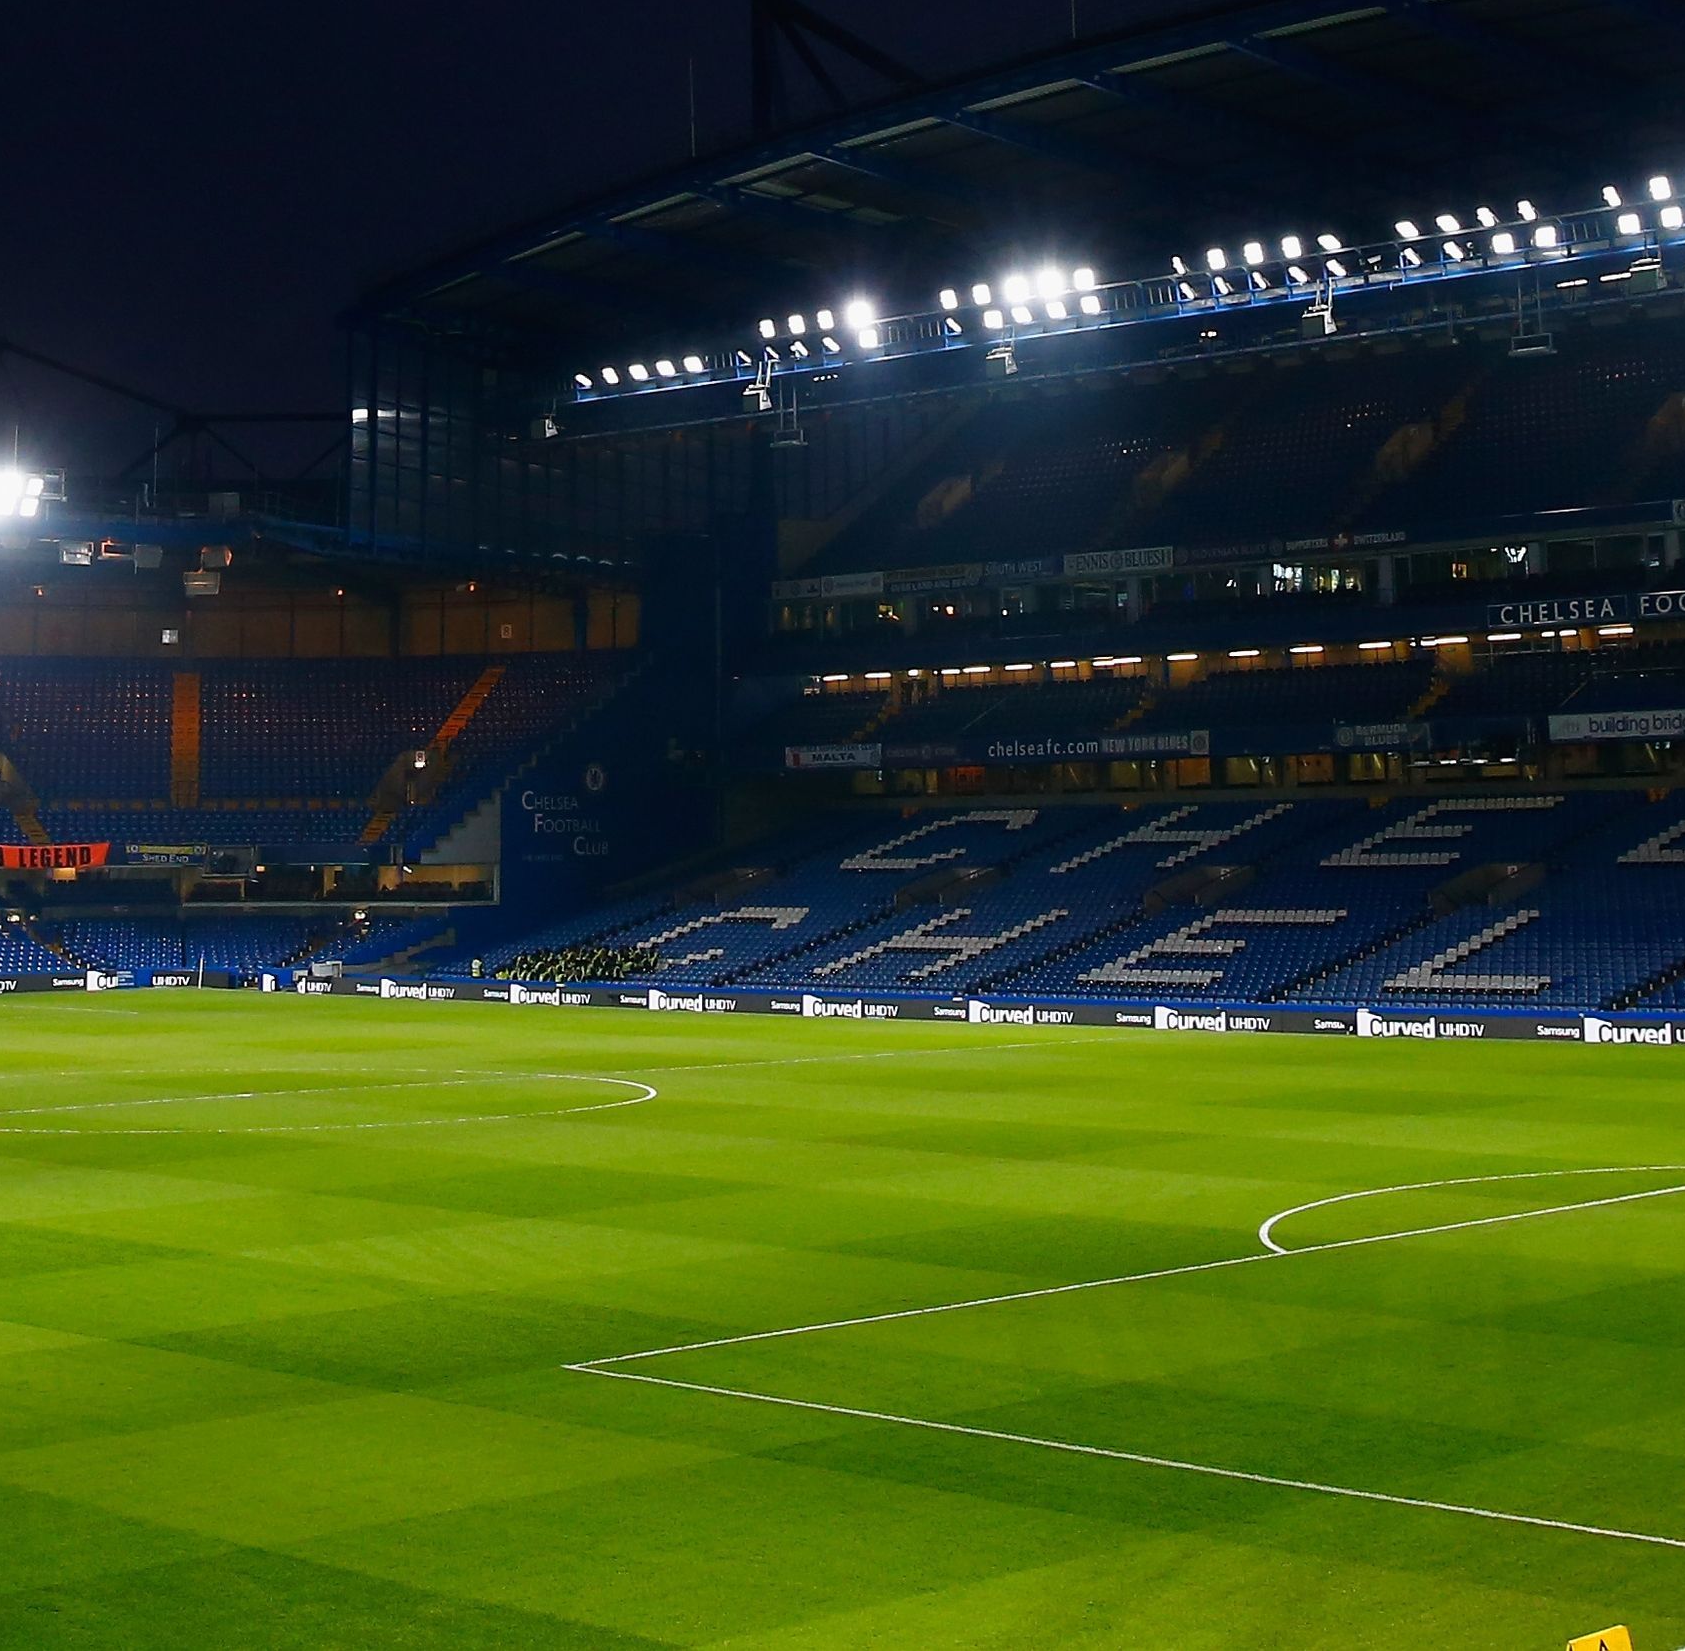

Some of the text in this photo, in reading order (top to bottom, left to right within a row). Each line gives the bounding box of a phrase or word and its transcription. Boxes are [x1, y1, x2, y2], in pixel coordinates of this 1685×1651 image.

[1018, 560, 1042, 573] WEST
[1499, 595, 1616, 626] CHELSEA
[1355, 723, 1408, 735] BERMUDA
[1588, 715, 1649, 735] building
[987, 738, 1099, 758] chelseafc.com
[1102, 735, 1189, 754] NEW YORK BLUES
[1364, 735, 1400, 746] BLUES
[812, 752, 856, 762] MALTA
[521, 790, 579, 810] CHELSEA
[534, 813, 601, 832] FOOTBALL
[573, 836, 609, 855] CLUB
[18, 847, 92, 868] LEGEND
[52, 977, 84, 988] Samsung
[152, 975, 190, 986] UHDTV
[356, 982, 379, 993] Samsung
[380, 978, 427, 998] Curved
[483, 989, 508, 1000] Samsung
[510, 984, 560, 1005] Curved
[619, 989, 737, 1012] Samsung Curved UHDTV
[770, 994, 898, 1018] Samsung Curved UHDTV
[933, 1000, 1074, 1024] Samsung Curved UHDTV
[1115, 1006, 1271, 1031] Samsung Curved UHDTV
[1356, 1012, 1436, 1038] Curved
[1439, 1023, 1485, 1037] UHDTV
[1536, 1025, 1580, 1038] Samsung
[1583, 1017, 1672, 1044] Curved
